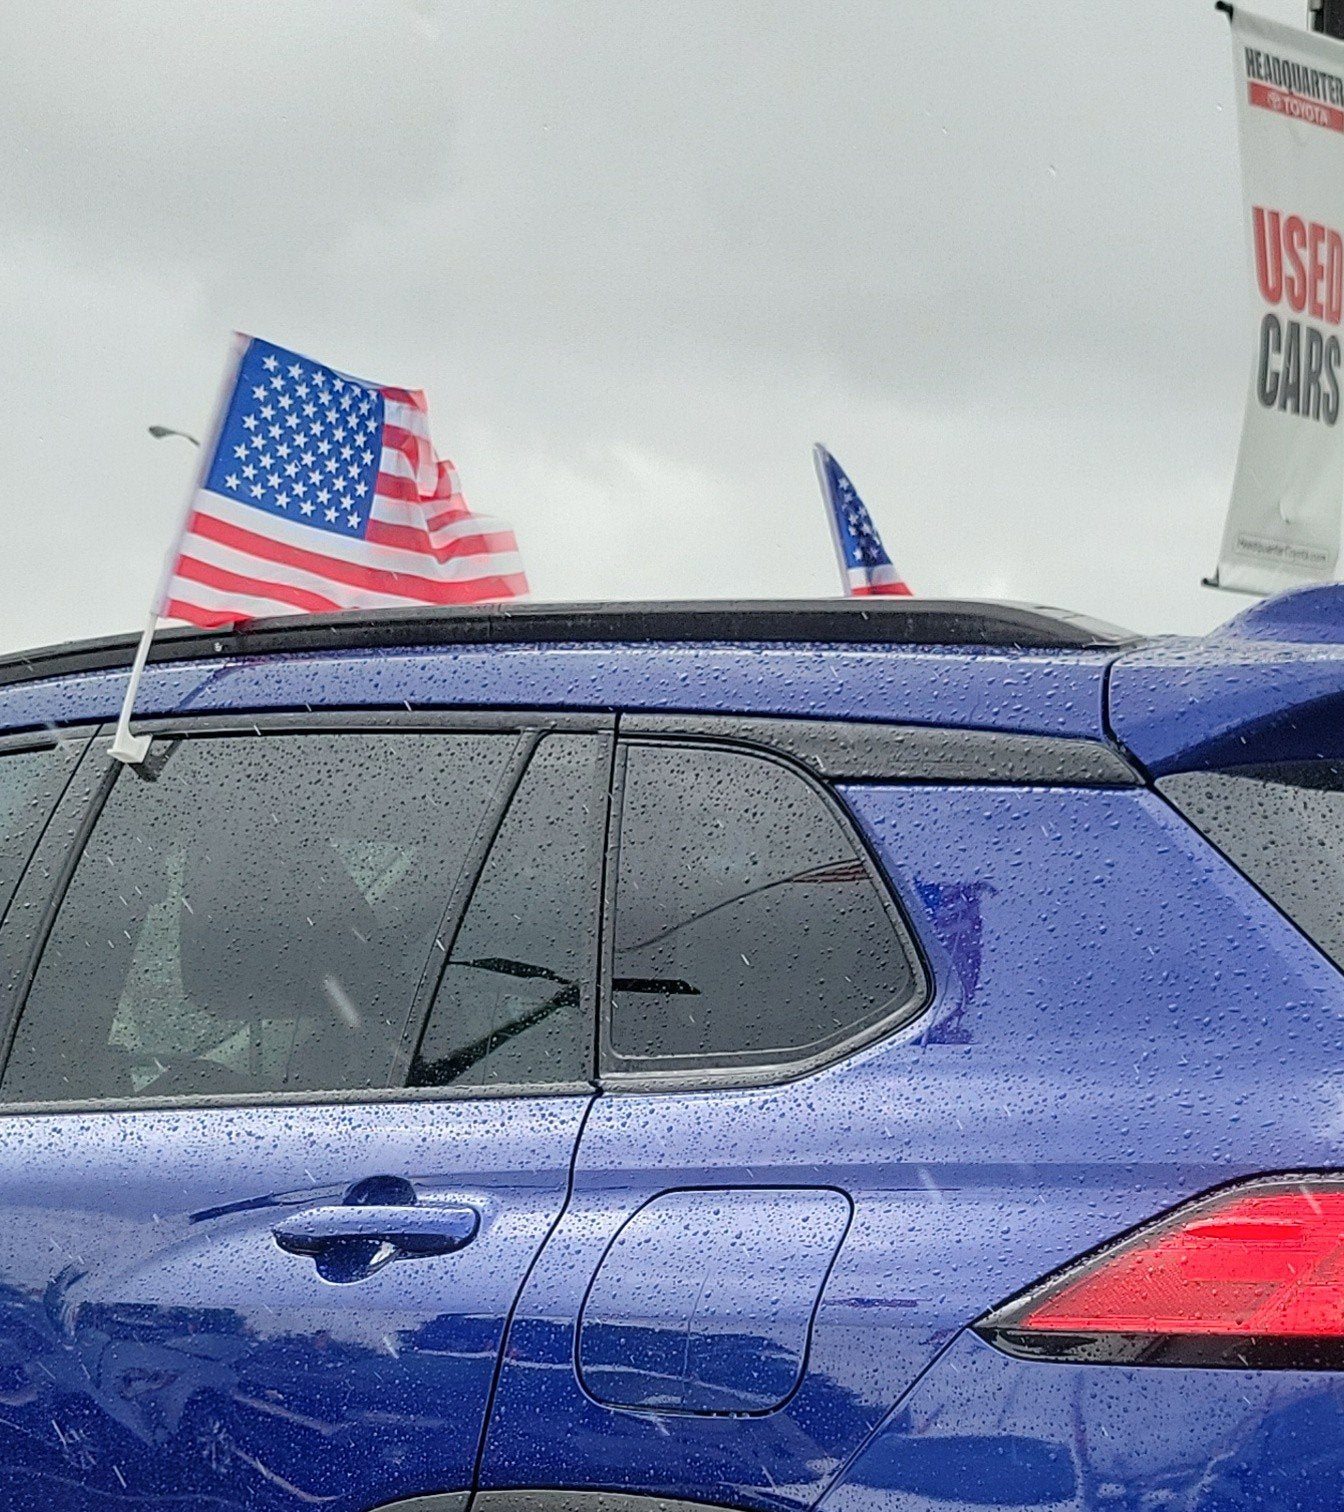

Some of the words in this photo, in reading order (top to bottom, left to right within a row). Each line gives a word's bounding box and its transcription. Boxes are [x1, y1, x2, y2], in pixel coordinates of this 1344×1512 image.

[1282, 95, 1329, 126] TOYOTA
[1252, 206, 1344, 326] USED
[1257, 312, 1342, 427] CARS
